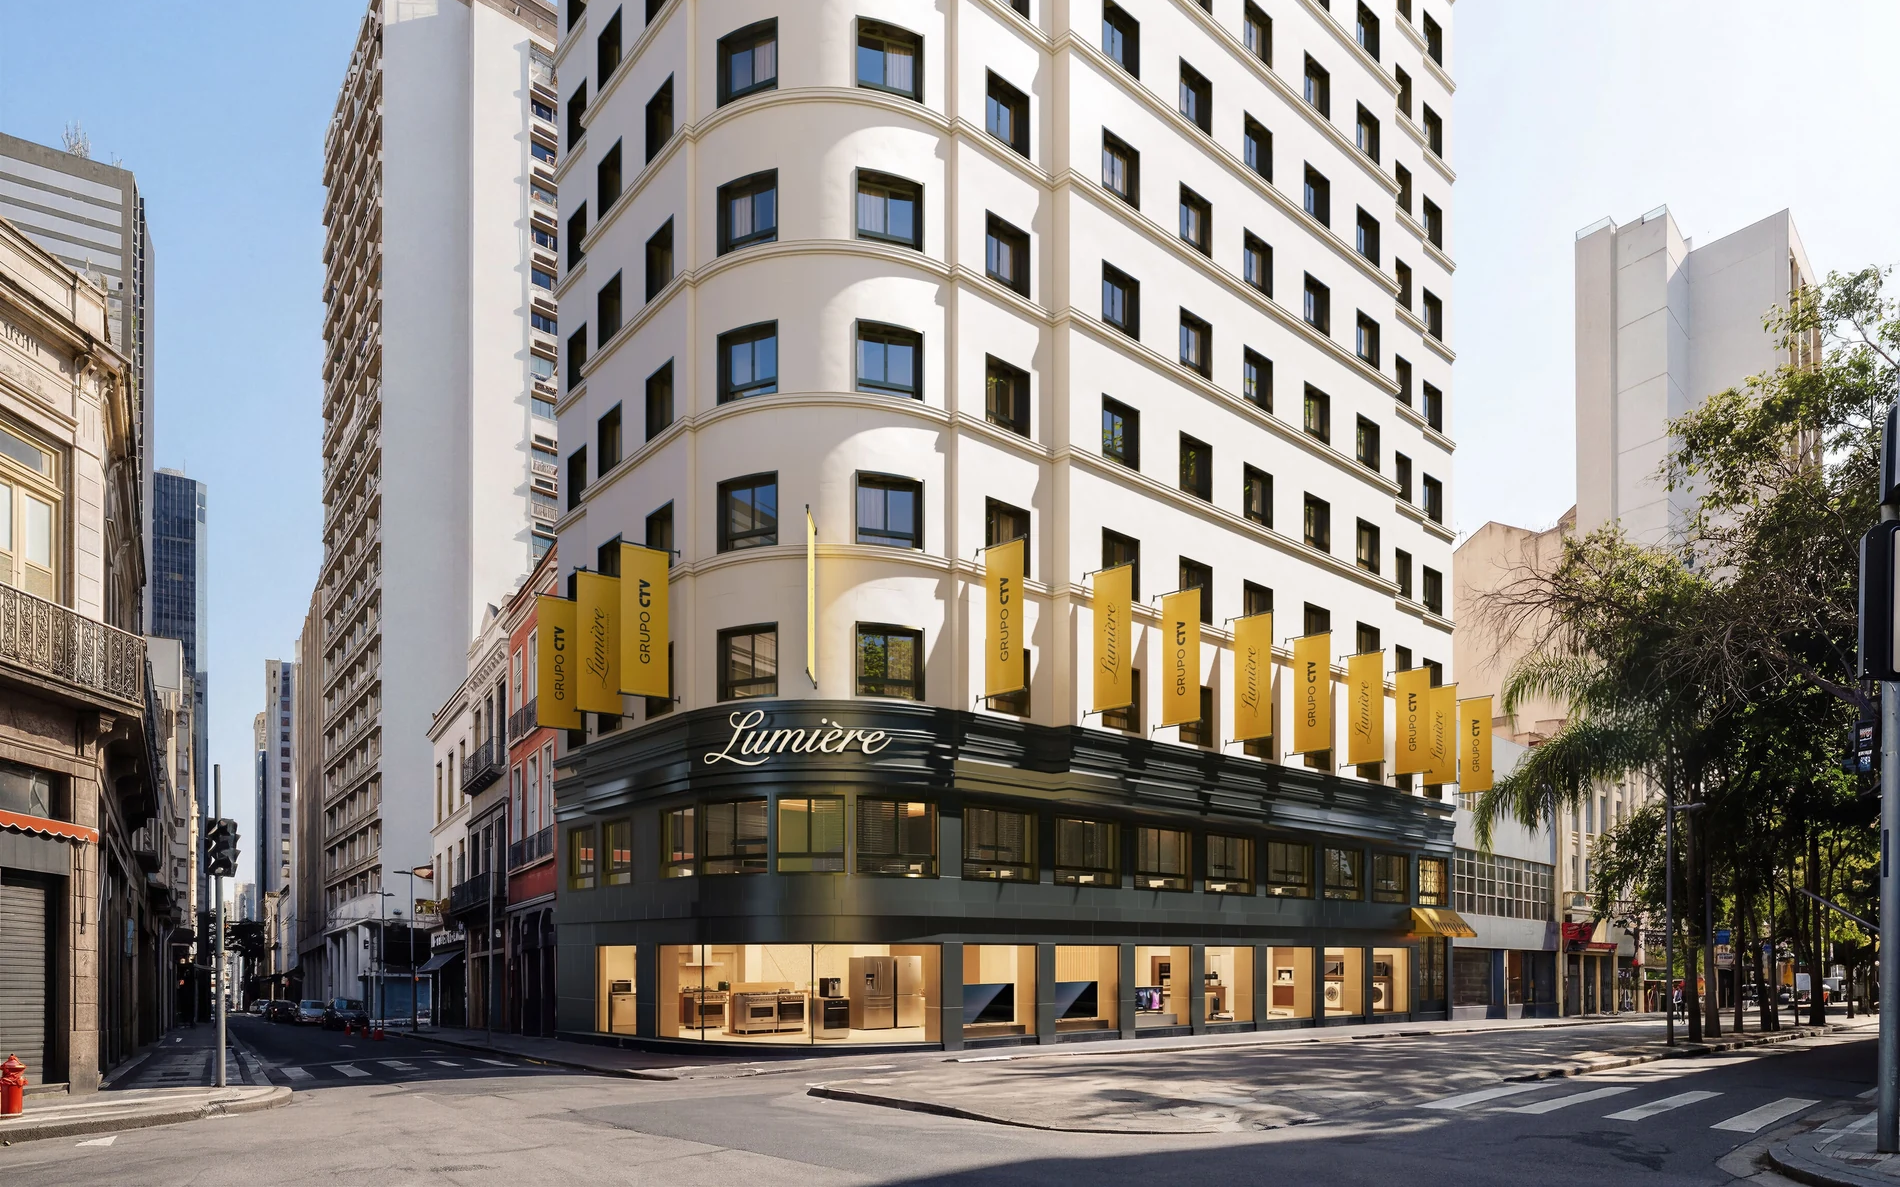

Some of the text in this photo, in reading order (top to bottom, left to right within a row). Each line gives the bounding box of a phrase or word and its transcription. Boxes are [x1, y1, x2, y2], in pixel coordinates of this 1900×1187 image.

[586, 606, 609, 690] Lumière
[639, 579, 651, 664] GRUPO CTV
[1000, 577, 1009, 662] GRUPO CTV
[1100, 601, 1120, 684] Lumière
[554, 626, 565, 701] GRUPO CTV
[1176, 621, 1186, 696] GRUPO CTV
[1241, 645, 1260, 718] Lumière
[1307, 661, 1317, 728] GRUPO CTV
[704, 709, 893, 766] Lumière
[1354, 679, 1373, 744] Lumière
[1408, 692, 1417, 752] GRUPO CTV
[1429, 709, 1446, 768] Lumière
[1472, 719, 1480, 773] GRUPO CTV
